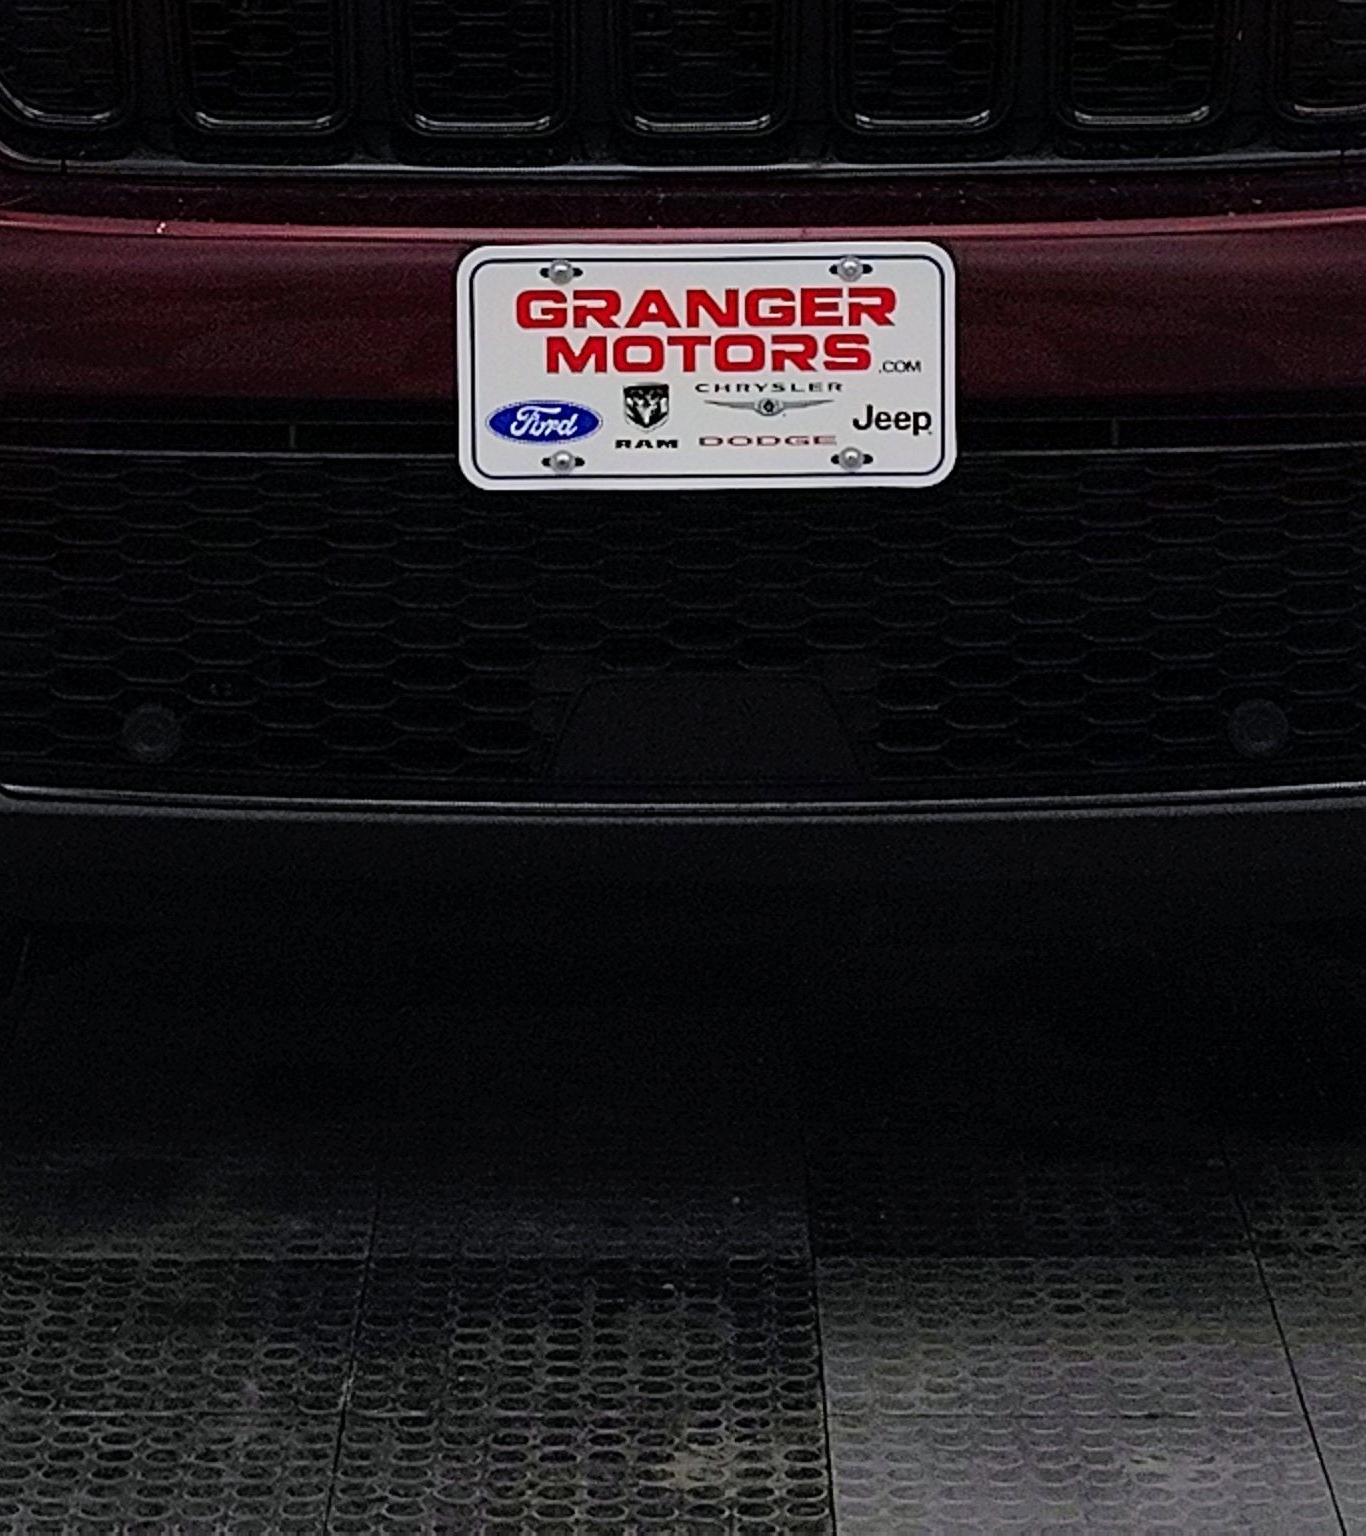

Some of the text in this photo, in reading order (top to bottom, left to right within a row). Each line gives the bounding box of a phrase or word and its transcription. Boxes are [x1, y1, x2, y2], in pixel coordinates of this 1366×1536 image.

[516, 287, 897, 330] GRANGER
[546, 334, 871, 374] MOTORS
[695, 382, 843, 393] CHRYSLER
[510, 405, 578, 437] Ford
[852, 404, 932, 436] Jeep
[615, 439, 678, 449] RAM
[699, 436, 837, 447] DODGE
